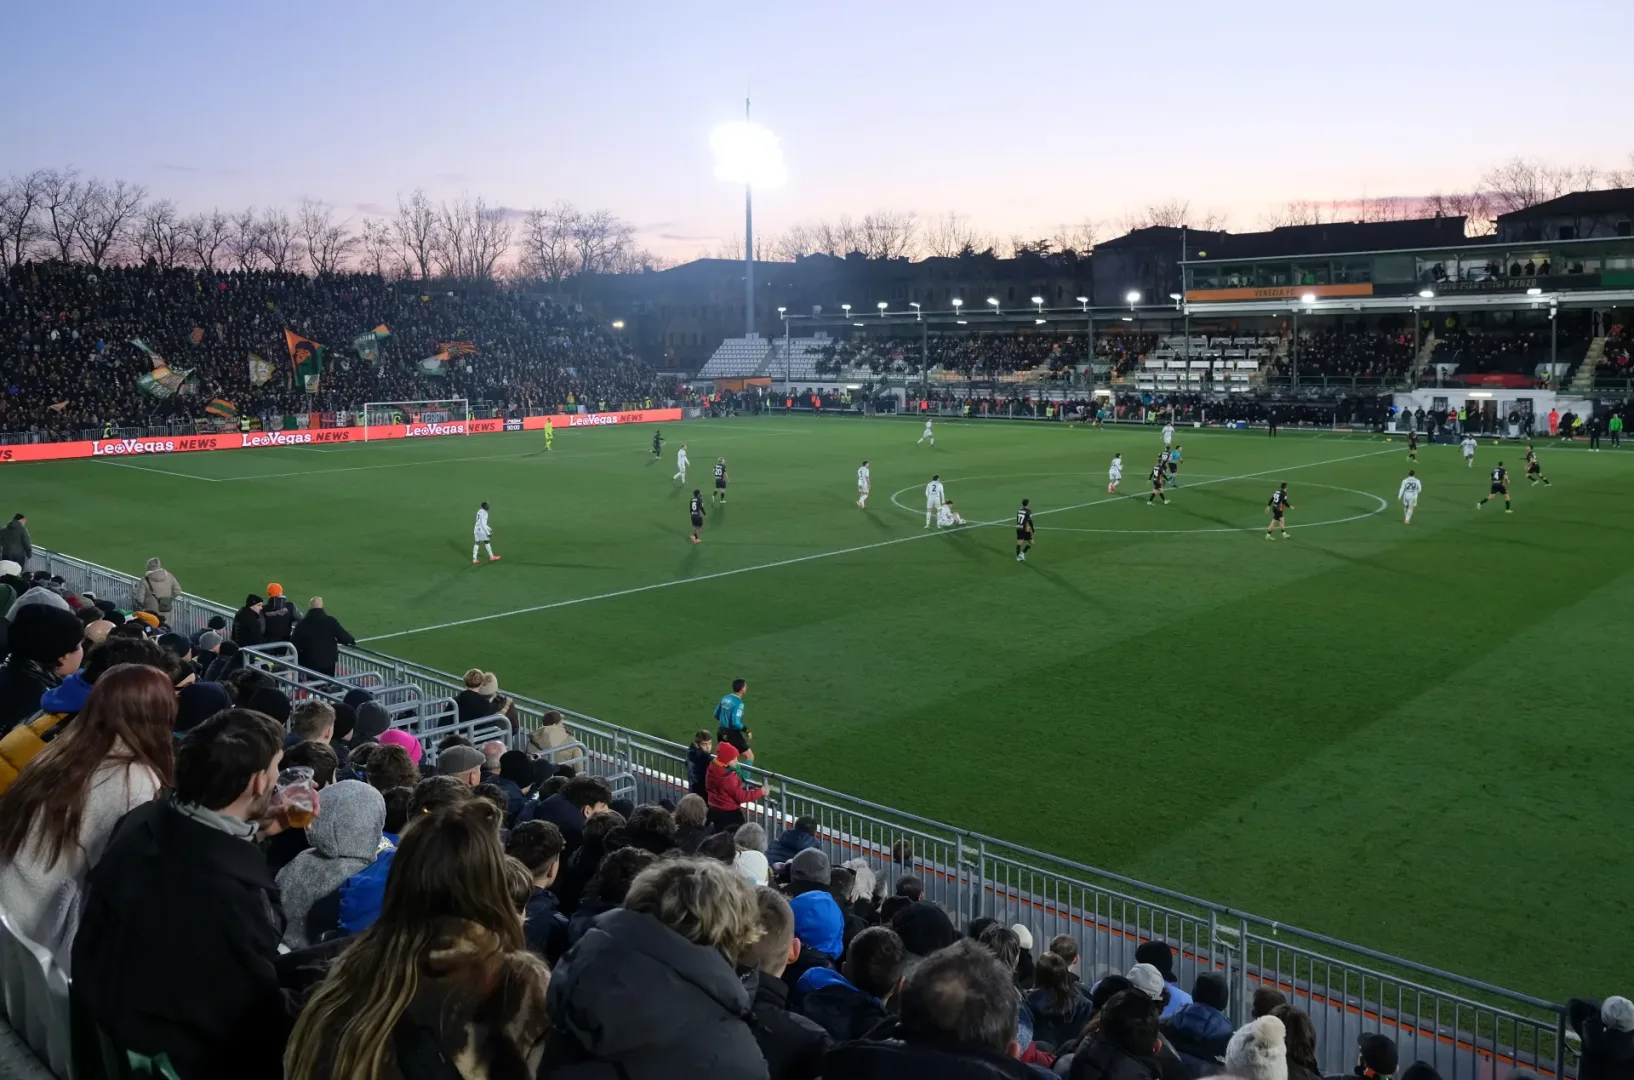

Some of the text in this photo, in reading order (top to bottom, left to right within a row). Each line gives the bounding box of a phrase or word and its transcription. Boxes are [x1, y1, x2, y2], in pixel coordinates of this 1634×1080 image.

[1254, 288, 1284, 296] VENEZIA
[406, 424, 464, 437] LeoVegas
[242, 432, 312, 447] LeoVegas
[92, 439, 174, 455] LeoVegas
[932, 484, 937, 492] 2
[692, 502, 697, 511] 6
[1017, 513, 1025, 524] 17
